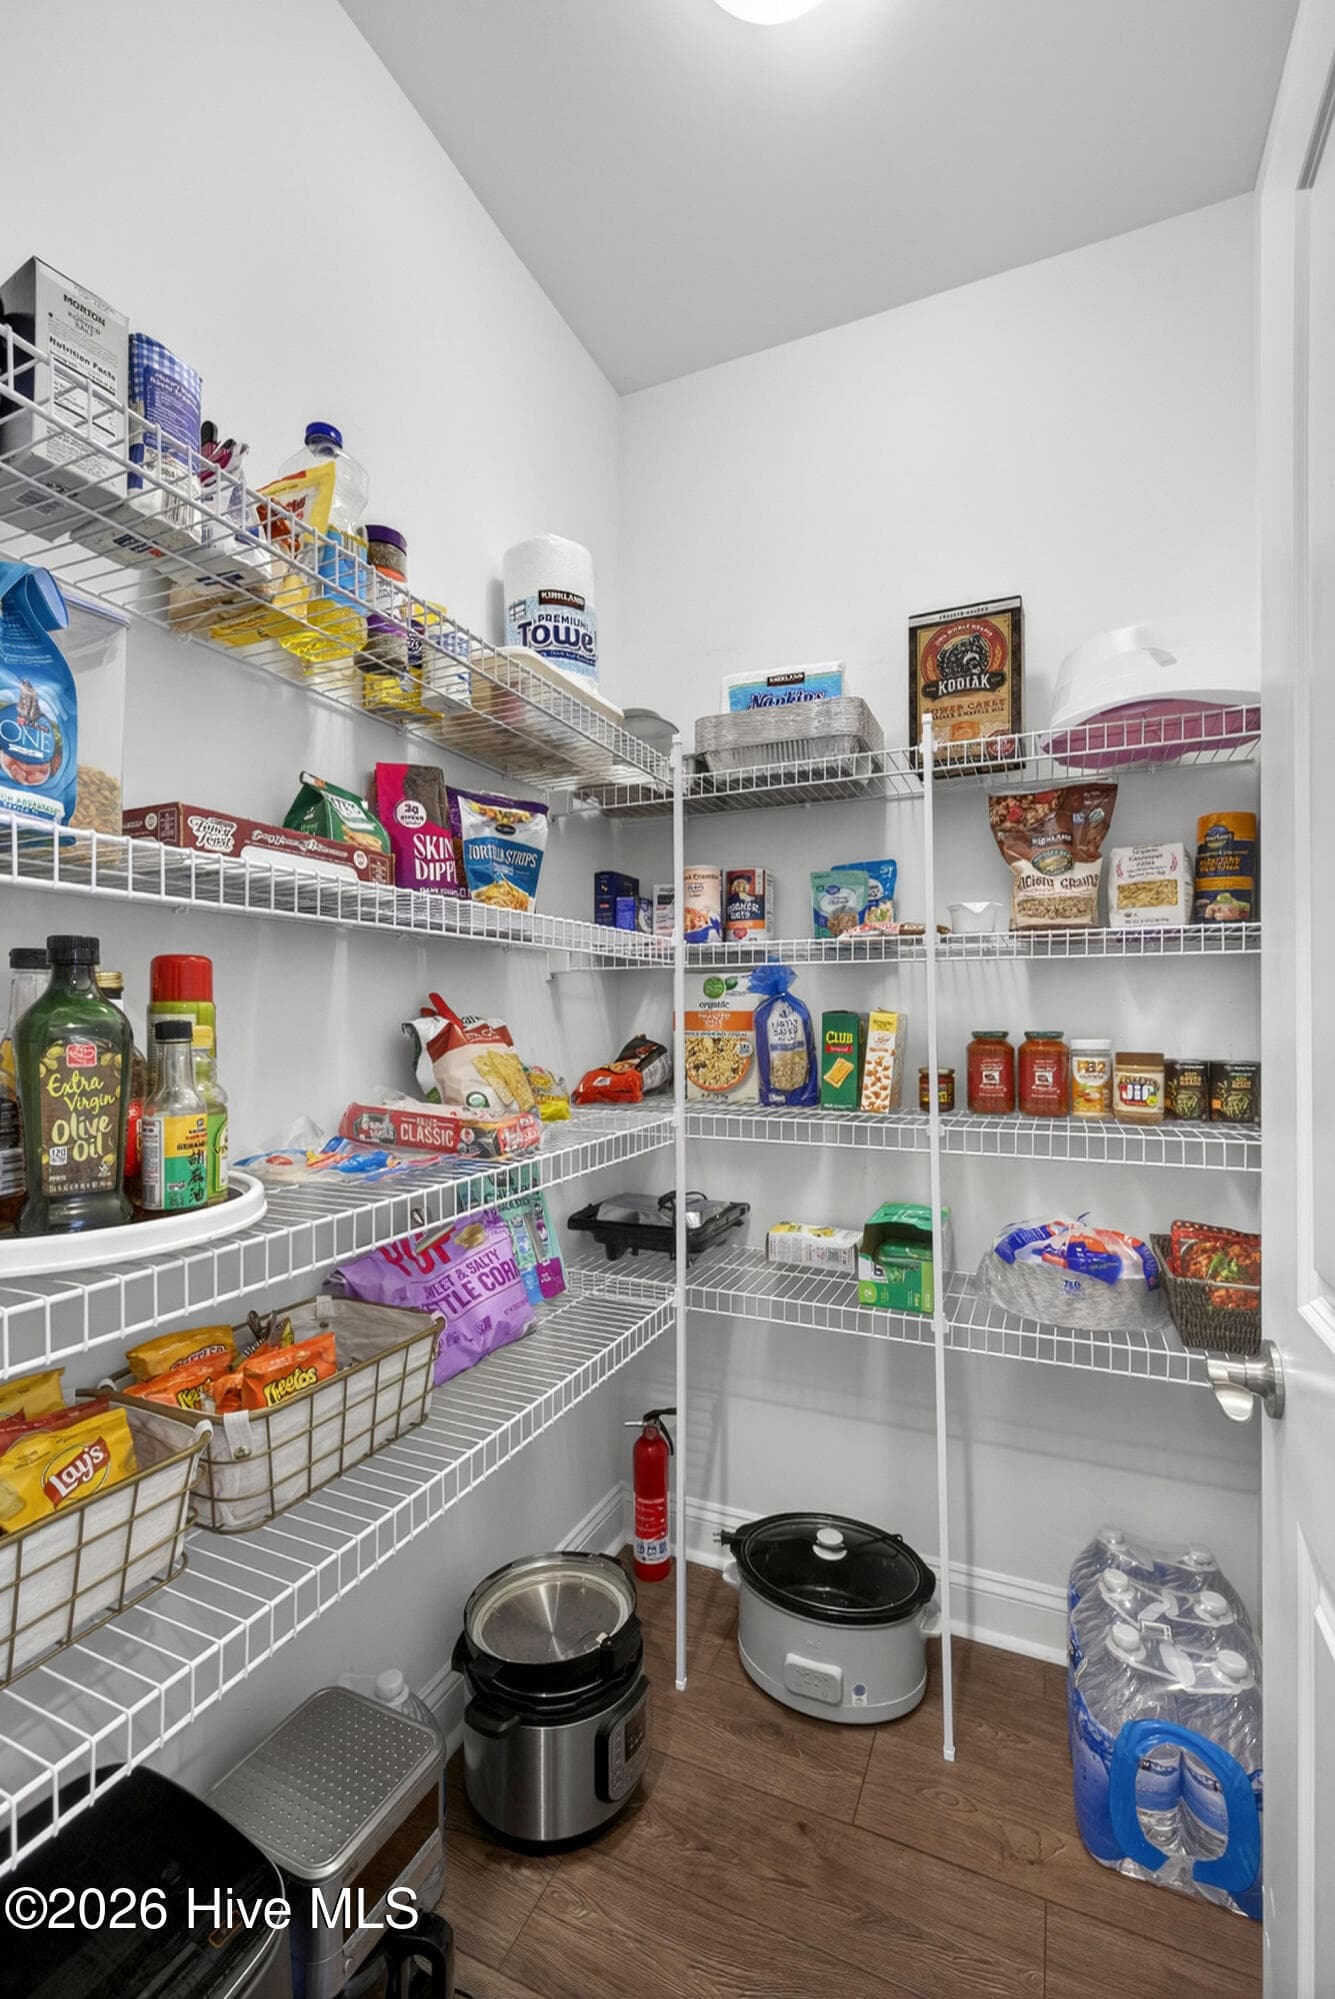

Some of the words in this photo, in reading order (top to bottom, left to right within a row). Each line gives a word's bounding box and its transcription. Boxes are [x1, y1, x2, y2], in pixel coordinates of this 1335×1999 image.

[63, 294, 105, 327] MORTON
[49, 337, 91, 366] Nutrition
[92, 361, 116, 381] Facts
[541, 591, 584, 606] KIRKLAND
[538, 613, 589, 631] PREMIUM
[769, 673, 804, 684] KIRKLAND
[938, 673, 990, 697] KODIAK
[747, 688, 826, 710] Napkins
[0, 719, 51, 752] ONE
[1031, 834, 1072, 846] HIGHLAND
[469, 844, 505, 862] TORTILLA
[506, 849, 538, 868] STRIPS
[699, 1001, 730, 1010] organic
[825, 1030, 854, 1044] CLUB
[47, 1070, 104, 1097] Extra
[1119, 1083, 1157, 1101] Jif
[64, 1094, 115, 1115] Virgin
[52, 1112, 112, 1144] Olive
[400, 1122, 455, 1148] CLASSIC
[72, 1131, 104, 1162] Oil
[455, 1269, 469, 1281] &
[466, 1248, 501, 1275] SALTY
[264, 1367, 317, 1408] Cheetos
[49, 1445, 105, 1497] Lay's
